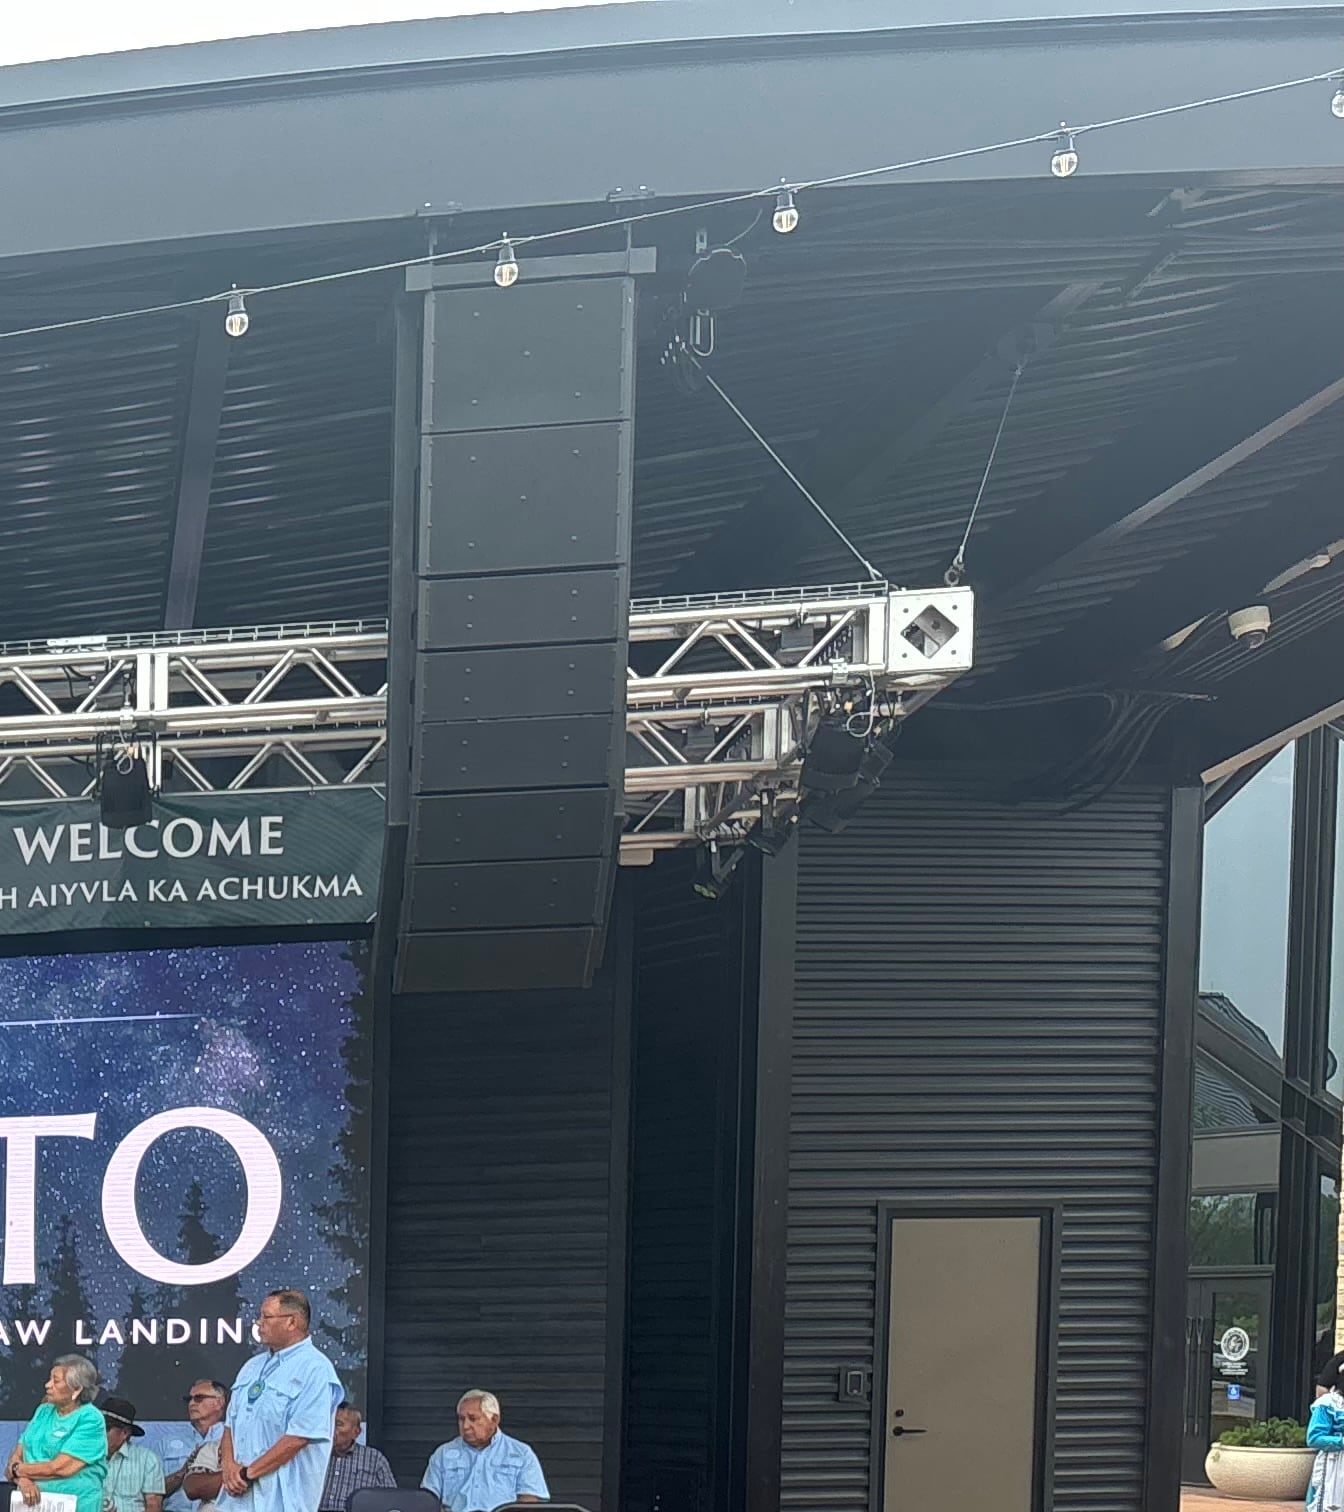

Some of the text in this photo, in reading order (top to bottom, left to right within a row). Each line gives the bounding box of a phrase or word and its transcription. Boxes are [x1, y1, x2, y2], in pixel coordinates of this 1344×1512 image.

[12, 815, 285, 866] WELCOME
[27, 879, 138, 909] AIYVLA
[148, 878, 187, 903] KA
[195, 873, 364, 902] ACHUKMA
